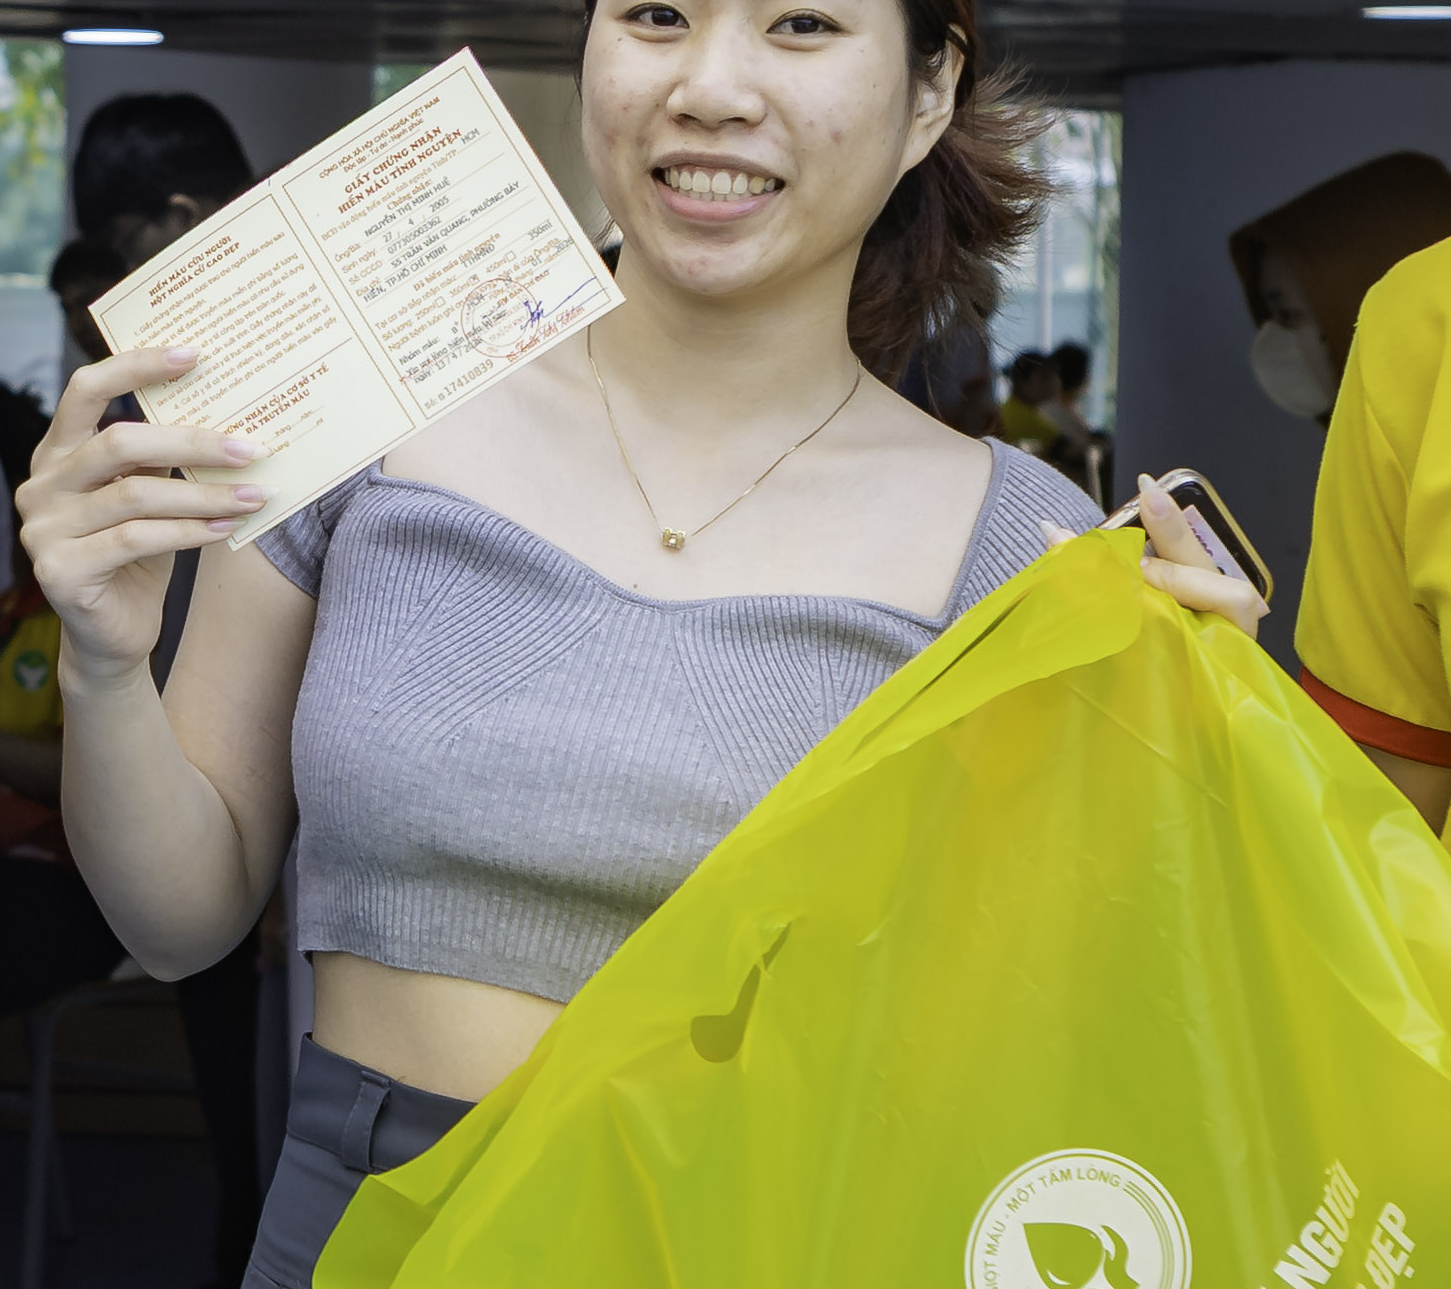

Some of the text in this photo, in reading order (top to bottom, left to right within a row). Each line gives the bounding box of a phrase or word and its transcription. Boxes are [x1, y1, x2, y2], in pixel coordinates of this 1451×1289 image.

[461, 128, 480, 144] HCM
[345, 126, 441, 193] GIẤY CHỨNG NHẬN
[338, 192, 364, 214] HIẾN
[365, 176, 390, 196] MÁU
[417, 129, 461, 162] NGUYỆN
[411, 189, 433, 206] MINH
[429, 195, 449, 213] 2005
[206, 254, 223, 268] CAO
[425, 244, 448, 262] MINH
[985, 1220, 1006, 1256] MÁU
[1006, 1183, 1037, 1213] MỘT
[1039, 1165, 1073, 1189] TẤM
[1077, 1163, 1122, 1188] LÒNG
